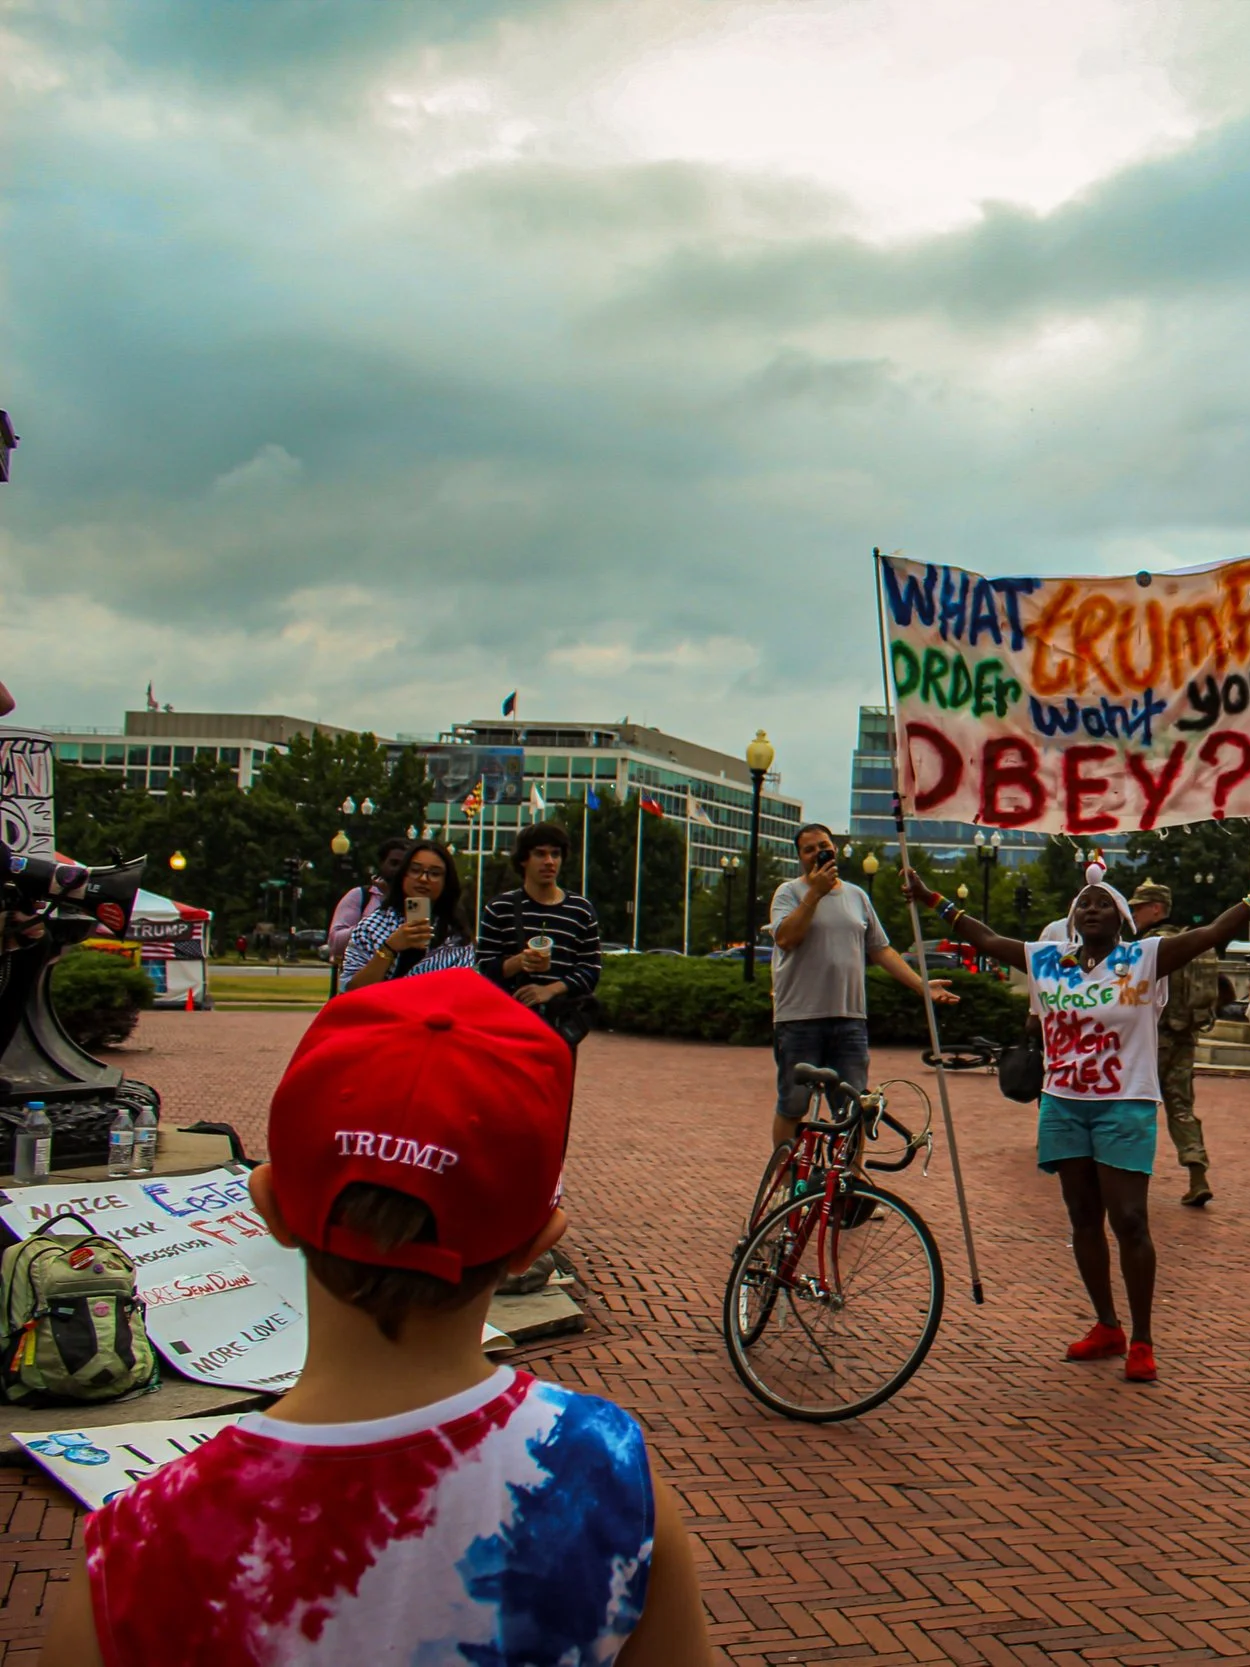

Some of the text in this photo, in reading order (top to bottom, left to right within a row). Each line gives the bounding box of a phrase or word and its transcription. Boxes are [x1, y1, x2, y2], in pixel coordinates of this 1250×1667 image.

[881, 557, 1042, 651] WHAT
[130, 924, 189, 938] TRUMP
[1046, 1055, 1123, 1095] FILES
[334, 1130, 460, 1175] TRUMP
[107, 1220, 167, 1242] KKK
[187, 1208, 271, 1247] FIL
[191, 1312, 289, 1375] MORE LOVE
